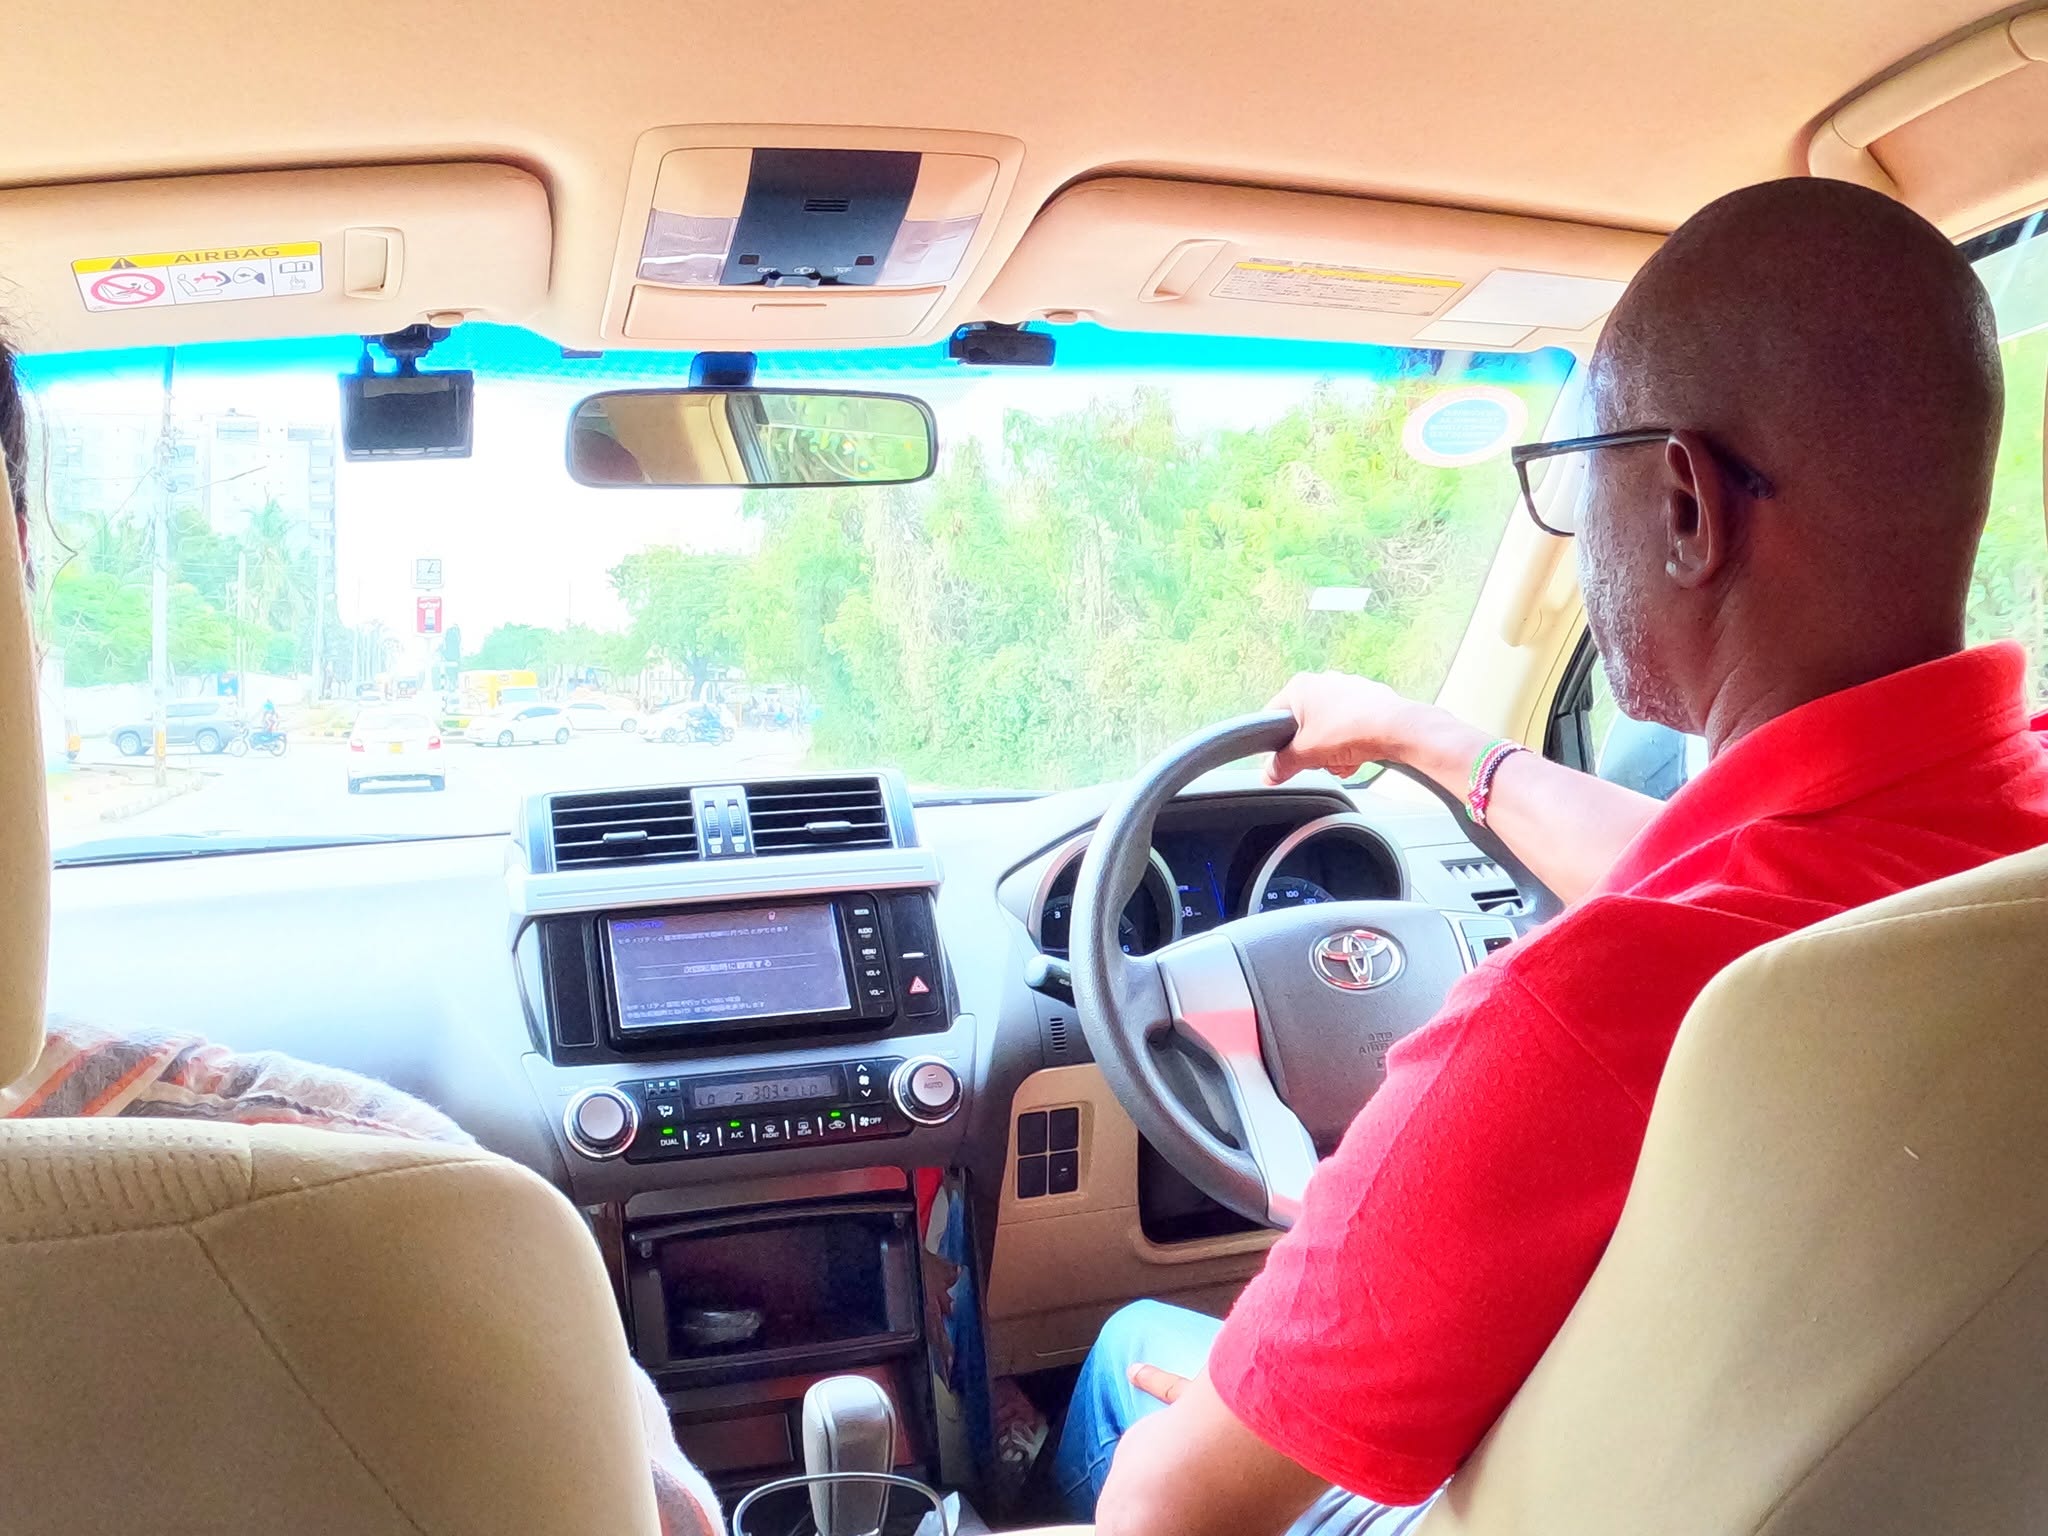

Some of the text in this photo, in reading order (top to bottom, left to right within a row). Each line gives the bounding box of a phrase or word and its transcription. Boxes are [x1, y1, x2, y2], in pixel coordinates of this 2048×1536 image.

[174, 246, 280, 264] AIRBAG
[1267, 892, 1278, 900] 80
[1285, 890, 1299, 898] 100
[1054, 911, 1061, 919] 3
[923, 1080, 944, 1089] AUTO
[869, 1116, 882, 1125] OFF
[730, 1131, 745, 1139] A/C
[762, 1131, 780, 1139] FRONT
[660, 1138, 679, 1147] DUAL
